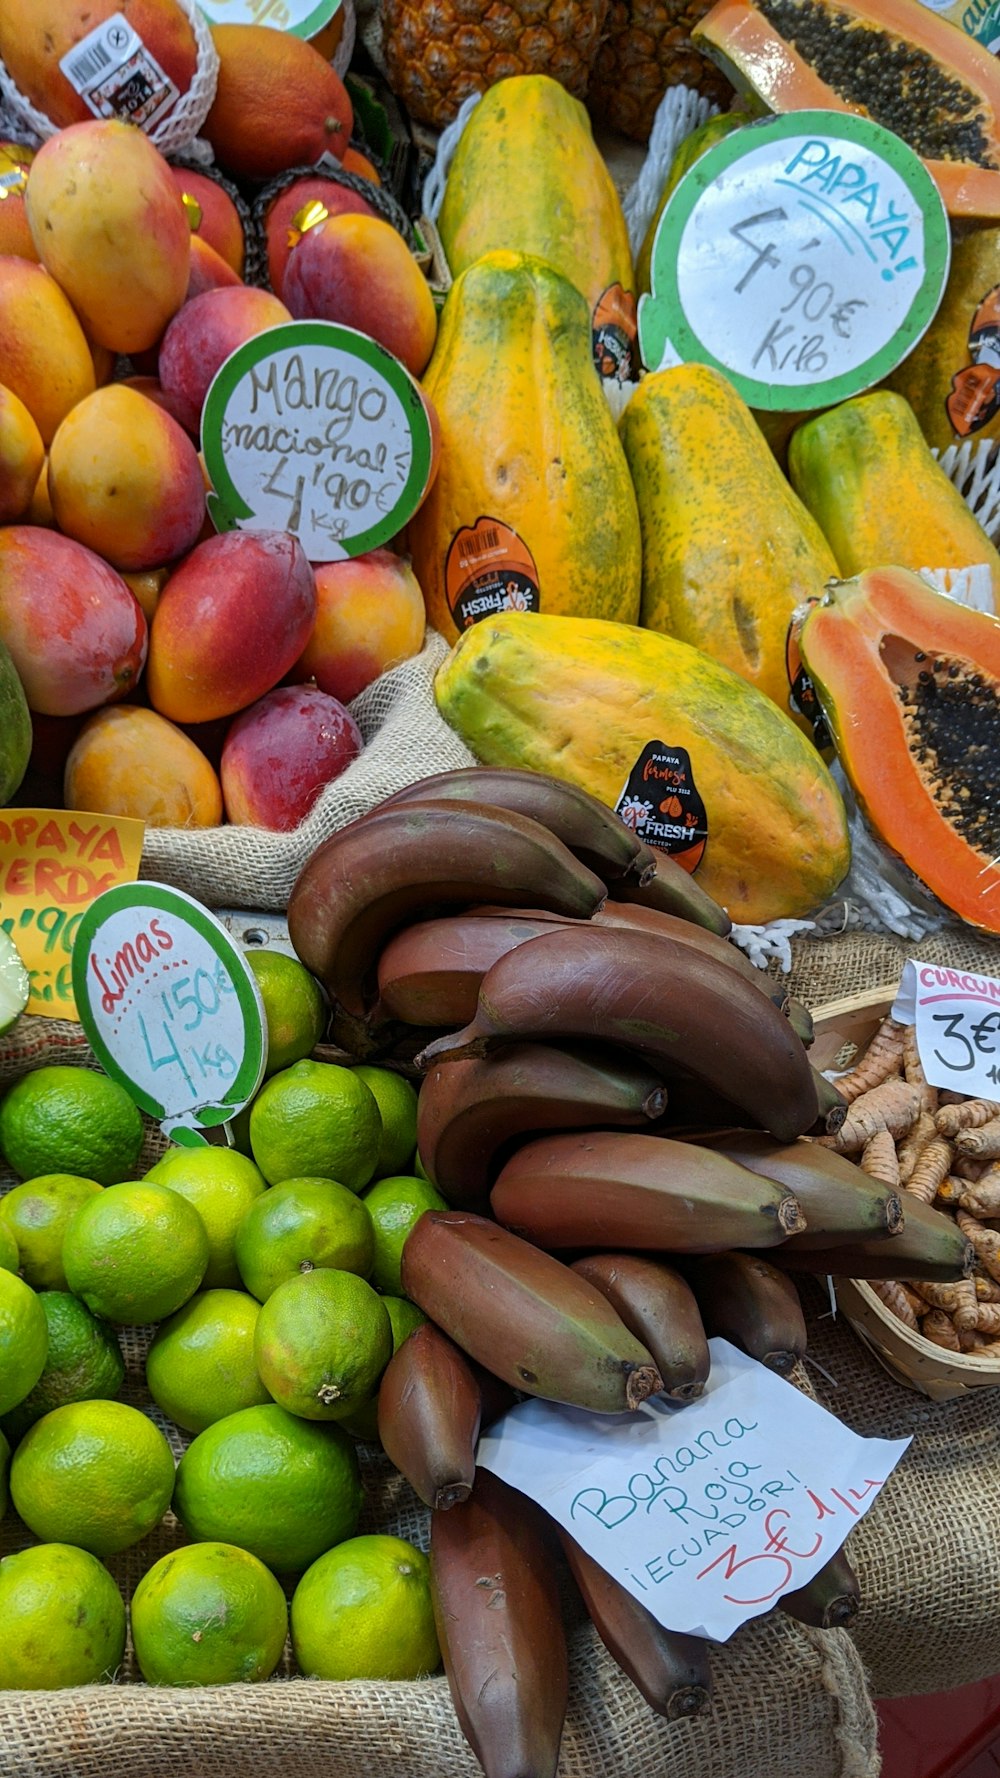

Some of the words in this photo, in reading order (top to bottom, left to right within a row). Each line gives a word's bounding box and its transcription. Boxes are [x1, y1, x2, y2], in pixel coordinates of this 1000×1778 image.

[785, 140, 918, 282] PAPAYA!
[752, 319, 828, 373] Kilo
[250, 354, 387, 445] Mango
[226, 422, 387, 474] nacional
[461, 592, 502, 617] FRESH
[652, 754, 680, 765] PAPAYA
[641, 838, 669, 847] ELECTED
[646, 822, 695, 841] FRESH
[91, 919, 173, 1014] Limas
[570, 1418, 758, 1529] Banana
[647, 1461, 762, 1525] Roja
